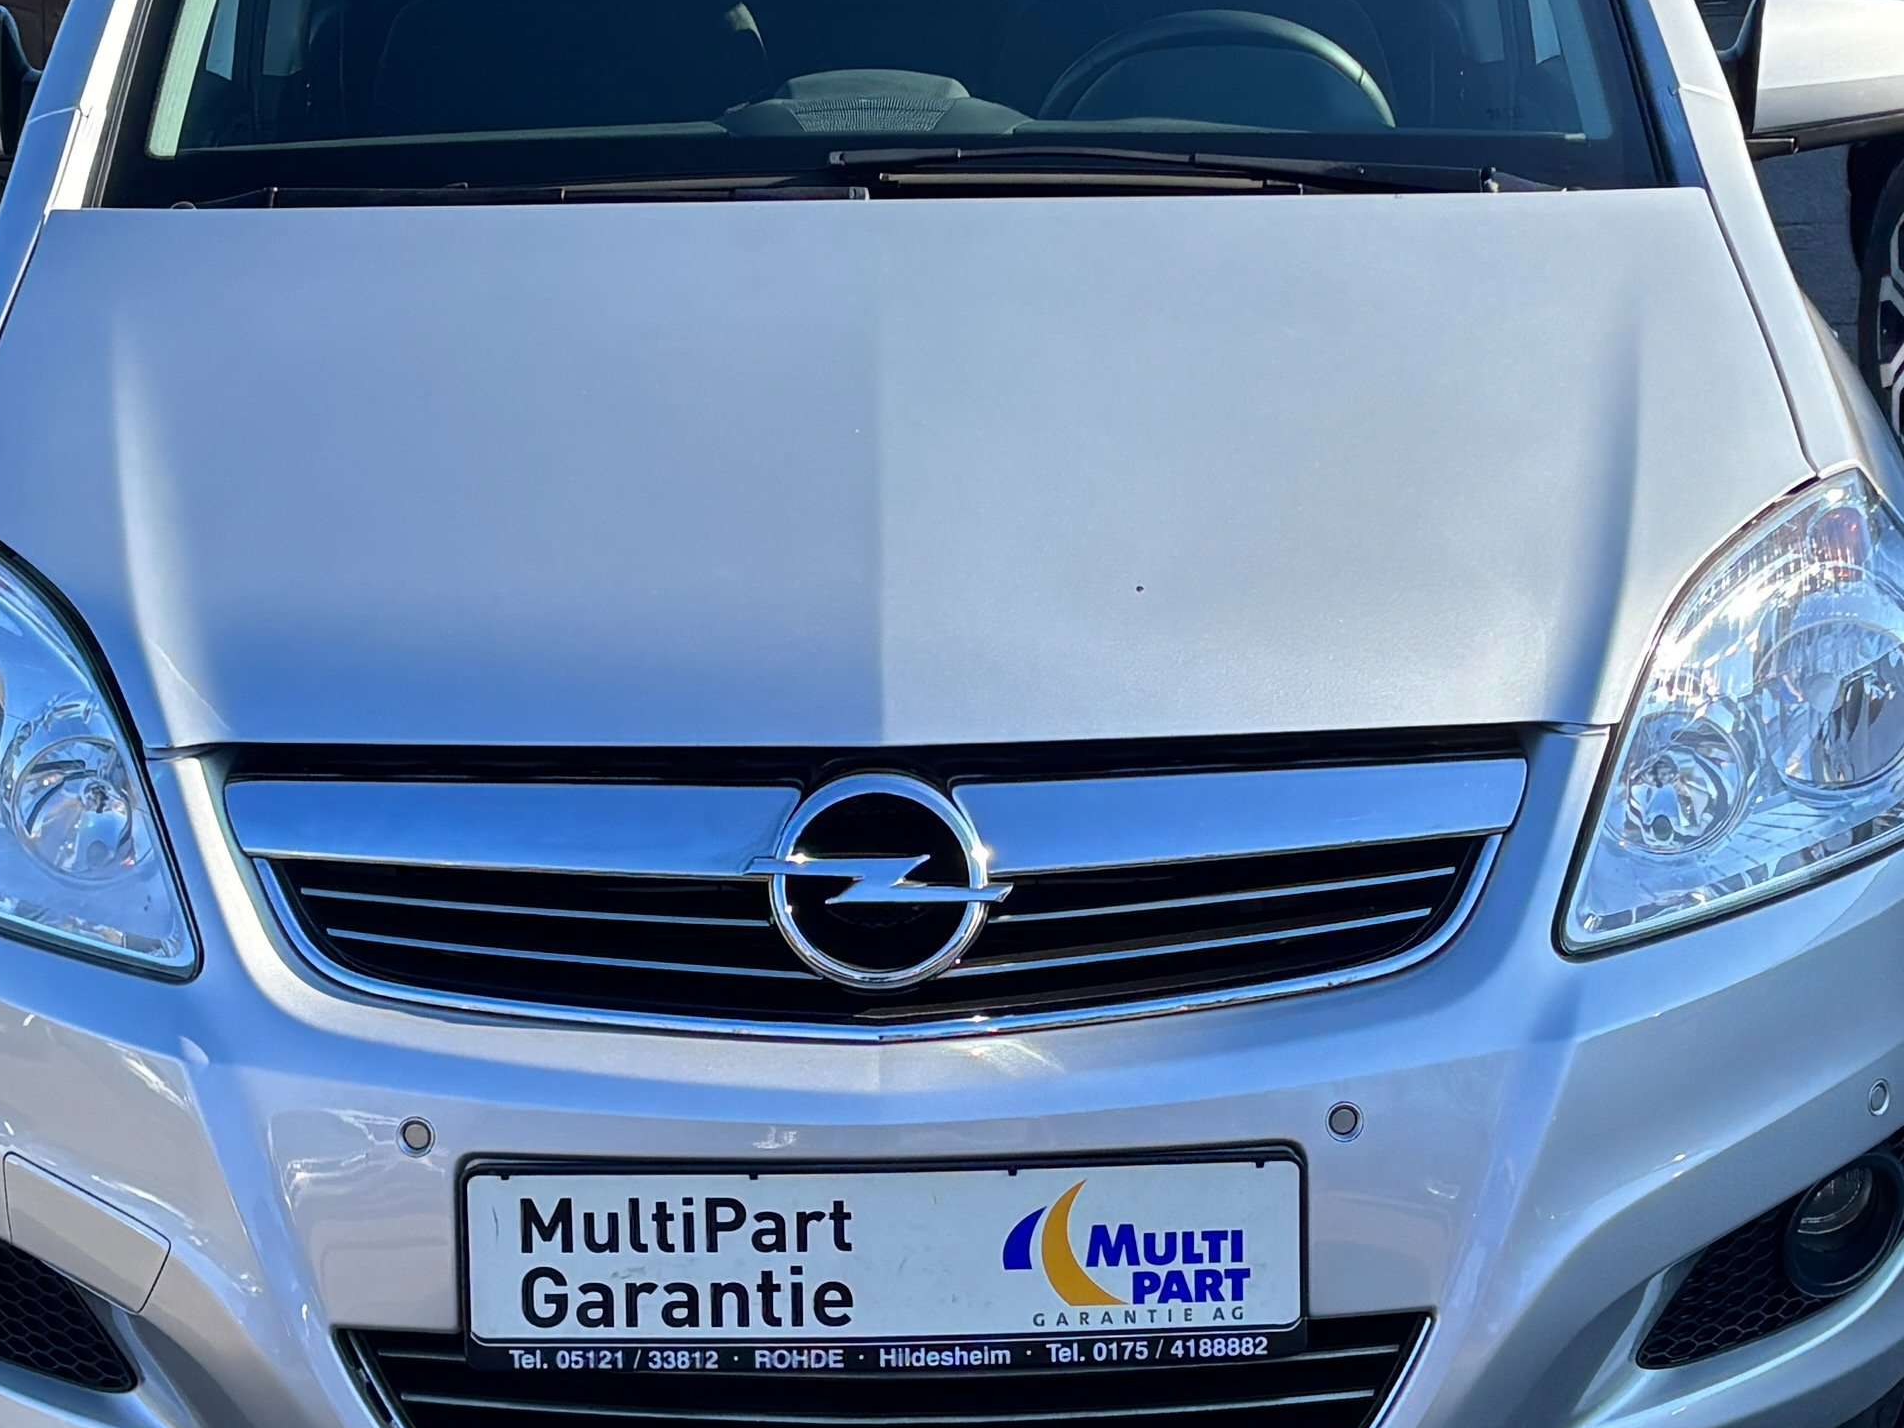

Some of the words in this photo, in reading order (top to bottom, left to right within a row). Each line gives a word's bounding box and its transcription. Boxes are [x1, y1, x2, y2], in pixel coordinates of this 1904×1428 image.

[519, 1196, 853, 1254] MultiPart
[1086, 1223, 1244, 1268] MULTI
[521, 1265, 854, 1328] Garantie
[1132, 1267, 1251, 1305] PART
[1033, 1307, 1194, 1327] GARANTIE
[1212, 1305, 1245, 1322] AG
[509, 1349, 548, 1370] Tel.
[555, 1349, 624, 1370] 05121
[633, 1348, 643, 1371] /
[648, 1349, 719, 1370] 33812
[754, 1349, 845, 1370] ROHDE
[879, 1345, 1012, 1369] Hildesheim
[1046, 1342, 1086, 1363] Tel.
[1092, 1340, 1149, 1362] 0175
[1155, 1338, 1165, 1359] /
[1170, 1336, 1268, 1357] 4188882
